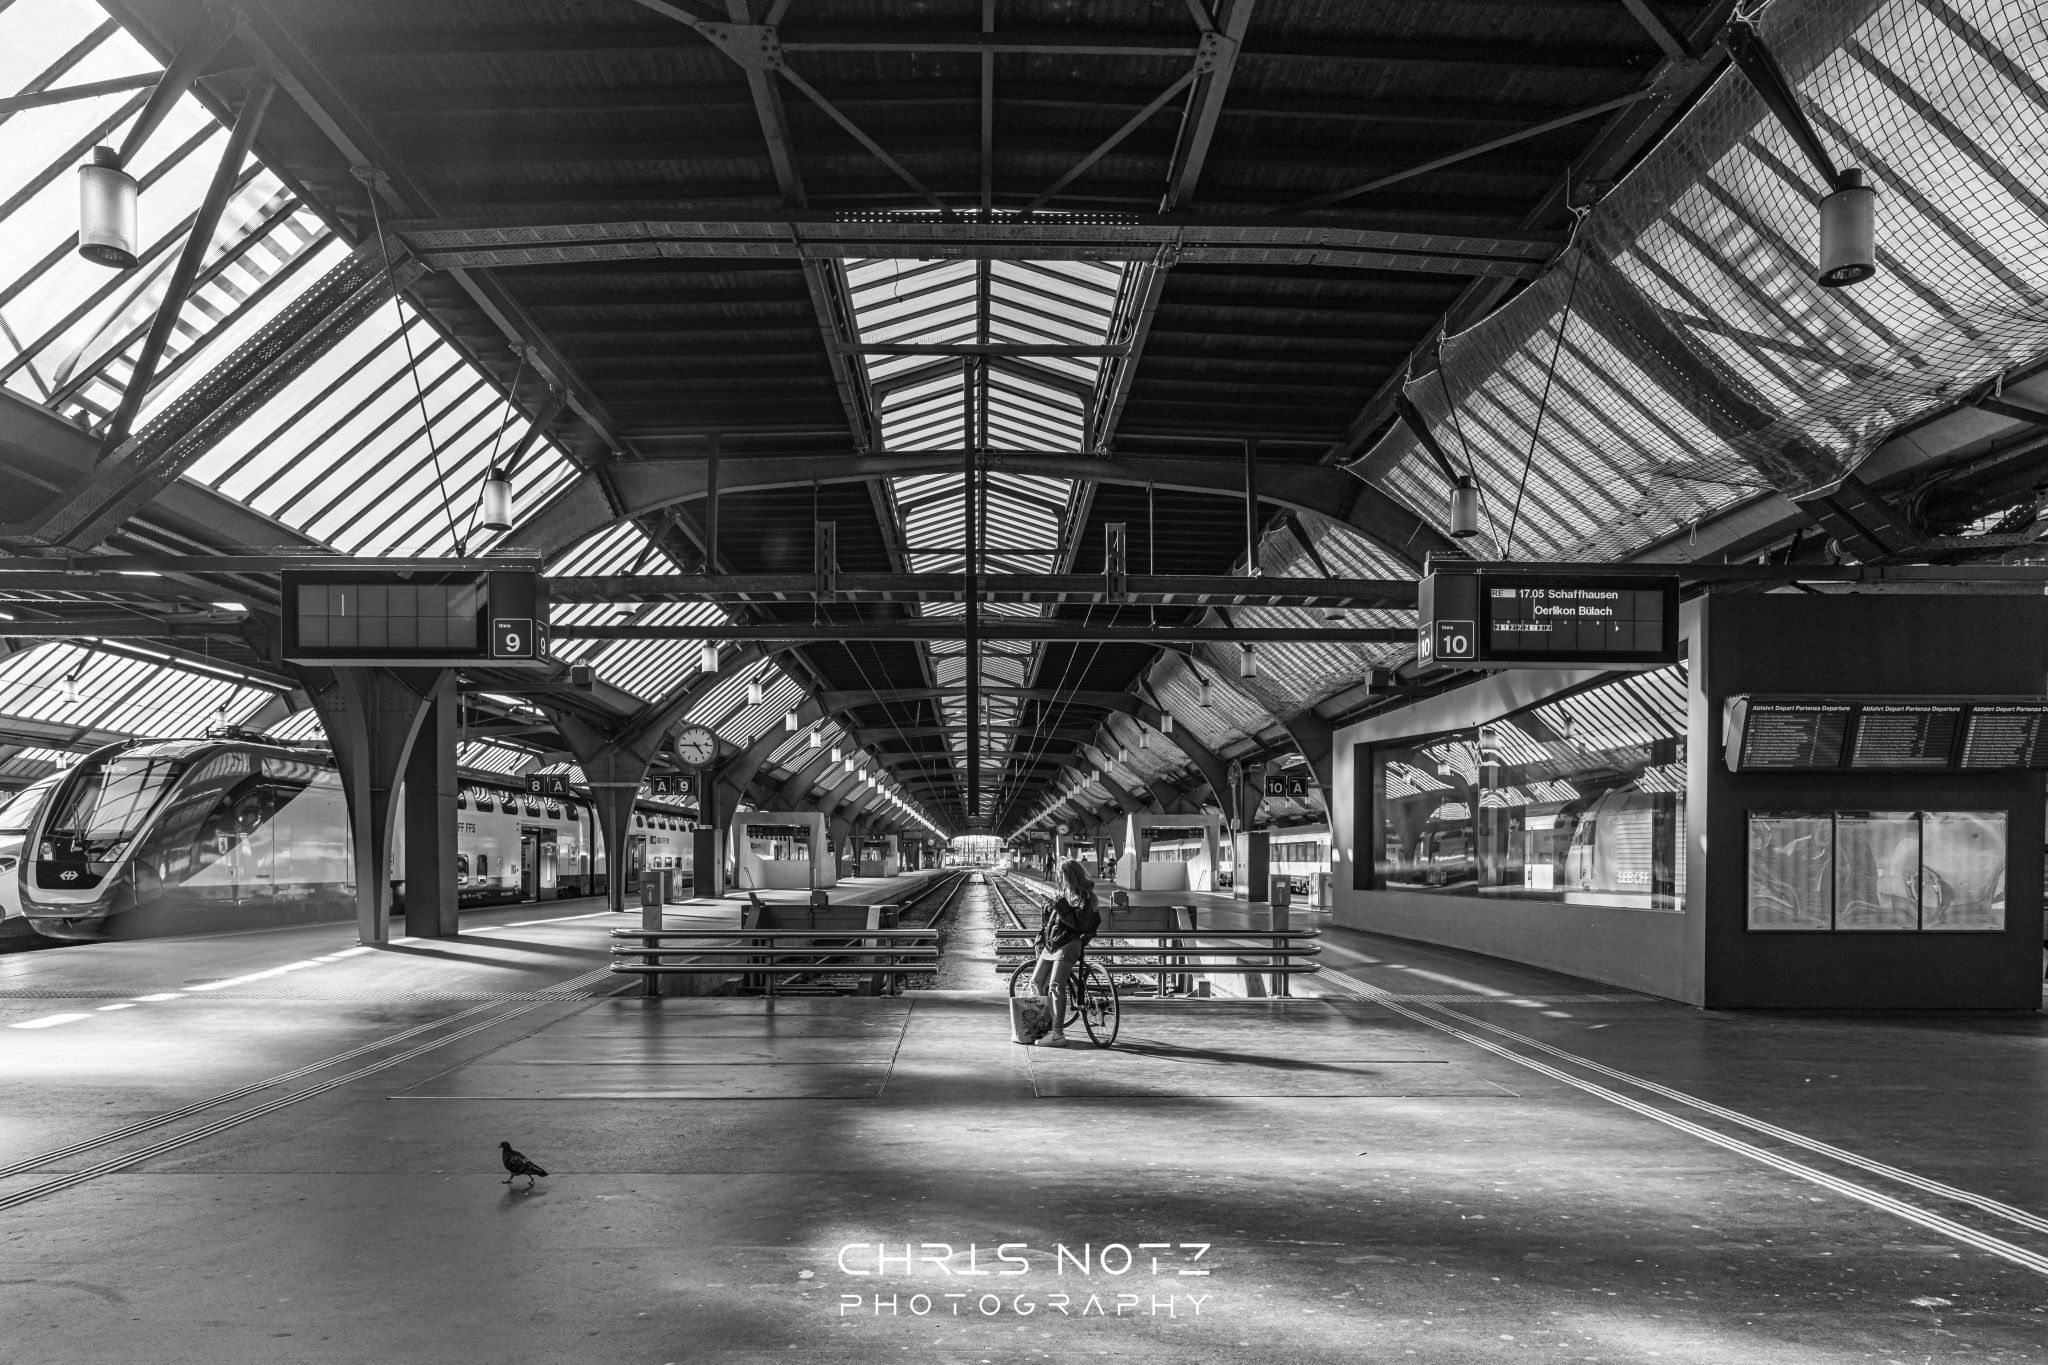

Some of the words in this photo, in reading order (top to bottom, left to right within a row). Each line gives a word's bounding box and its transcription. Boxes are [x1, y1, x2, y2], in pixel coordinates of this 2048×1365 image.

[1492, 589, 1504, 597] RE
[1519, 589, 1545, 598] 17.05
[1548, 589, 1619, 599] Schaffhausen
[1534, 606, 1576, 615] Oerlikon
[1579, 606, 1613, 616] Bülach
[506, 633, 520, 652] 9
[540, 637, 546, 655] 9
[1421, 637, 1430, 658] 10
[1443, 635, 1468, 654] 10
[532, 780, 541, 792] 8
[553, 780, 563, 792] A
[657, 781, 667, 792] A
[680, 781, 689, 792] 9
[1269, 782, 1282, 793] 10
[1293, 782, 1303, 793] A
[465, 822, 476, 834] FFS
